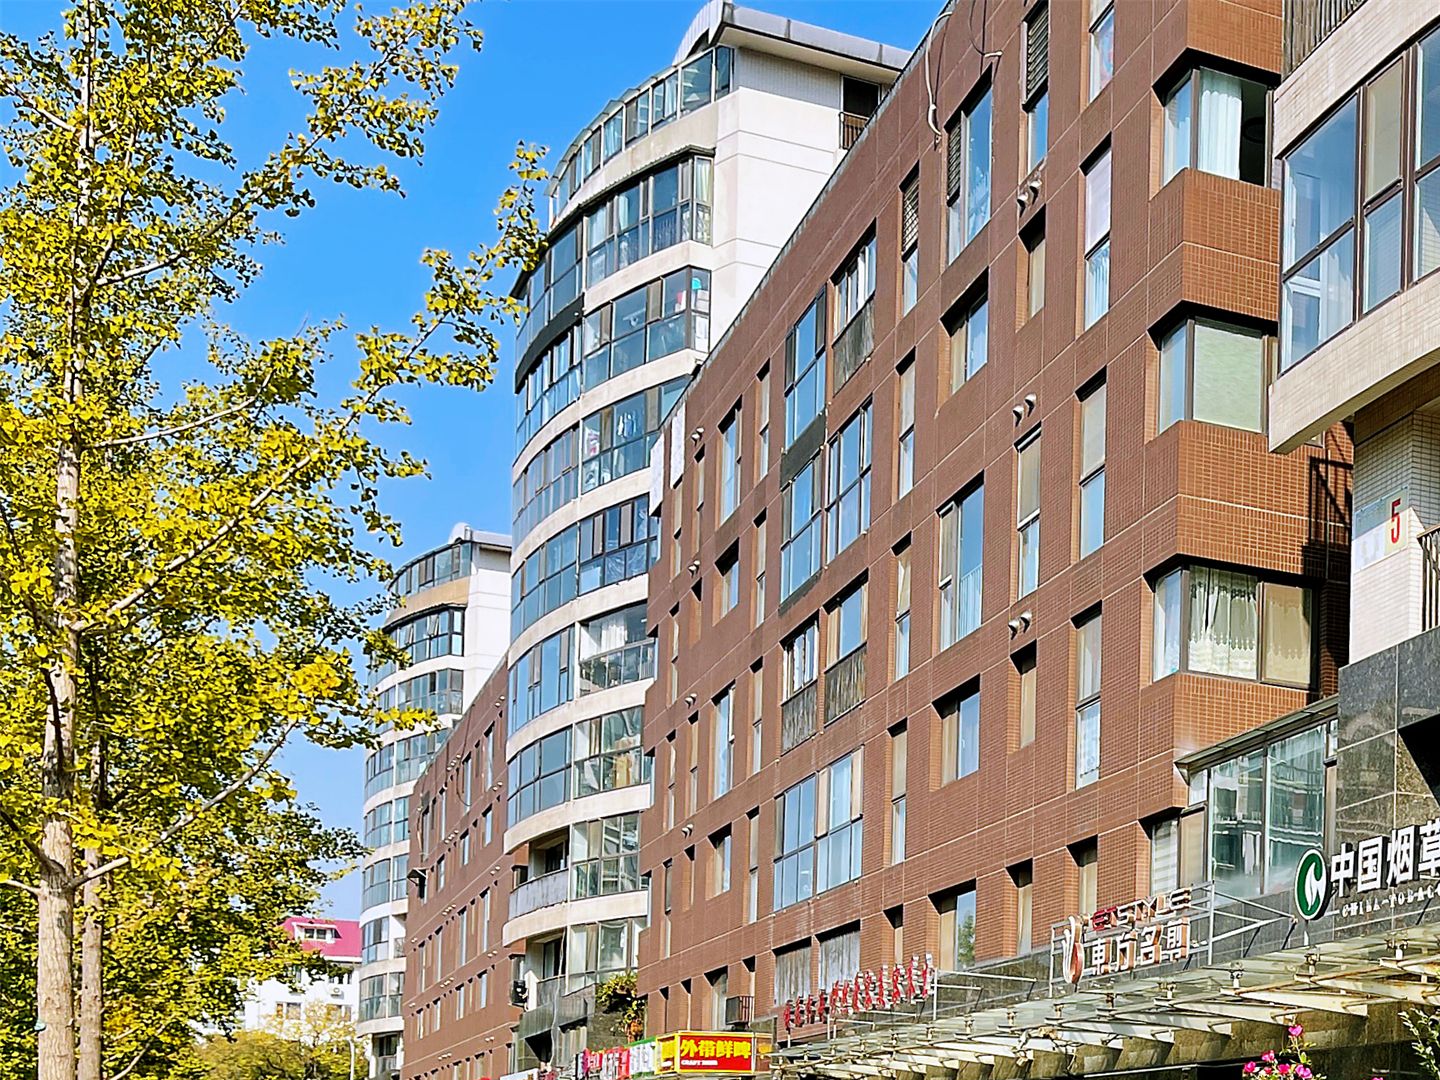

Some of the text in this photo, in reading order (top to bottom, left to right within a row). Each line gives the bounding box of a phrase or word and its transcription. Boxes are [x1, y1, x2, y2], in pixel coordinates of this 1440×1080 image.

[1391, 498, 1402, 544] 5
[680, 1039, 752, 1059] 外带鲜啤
